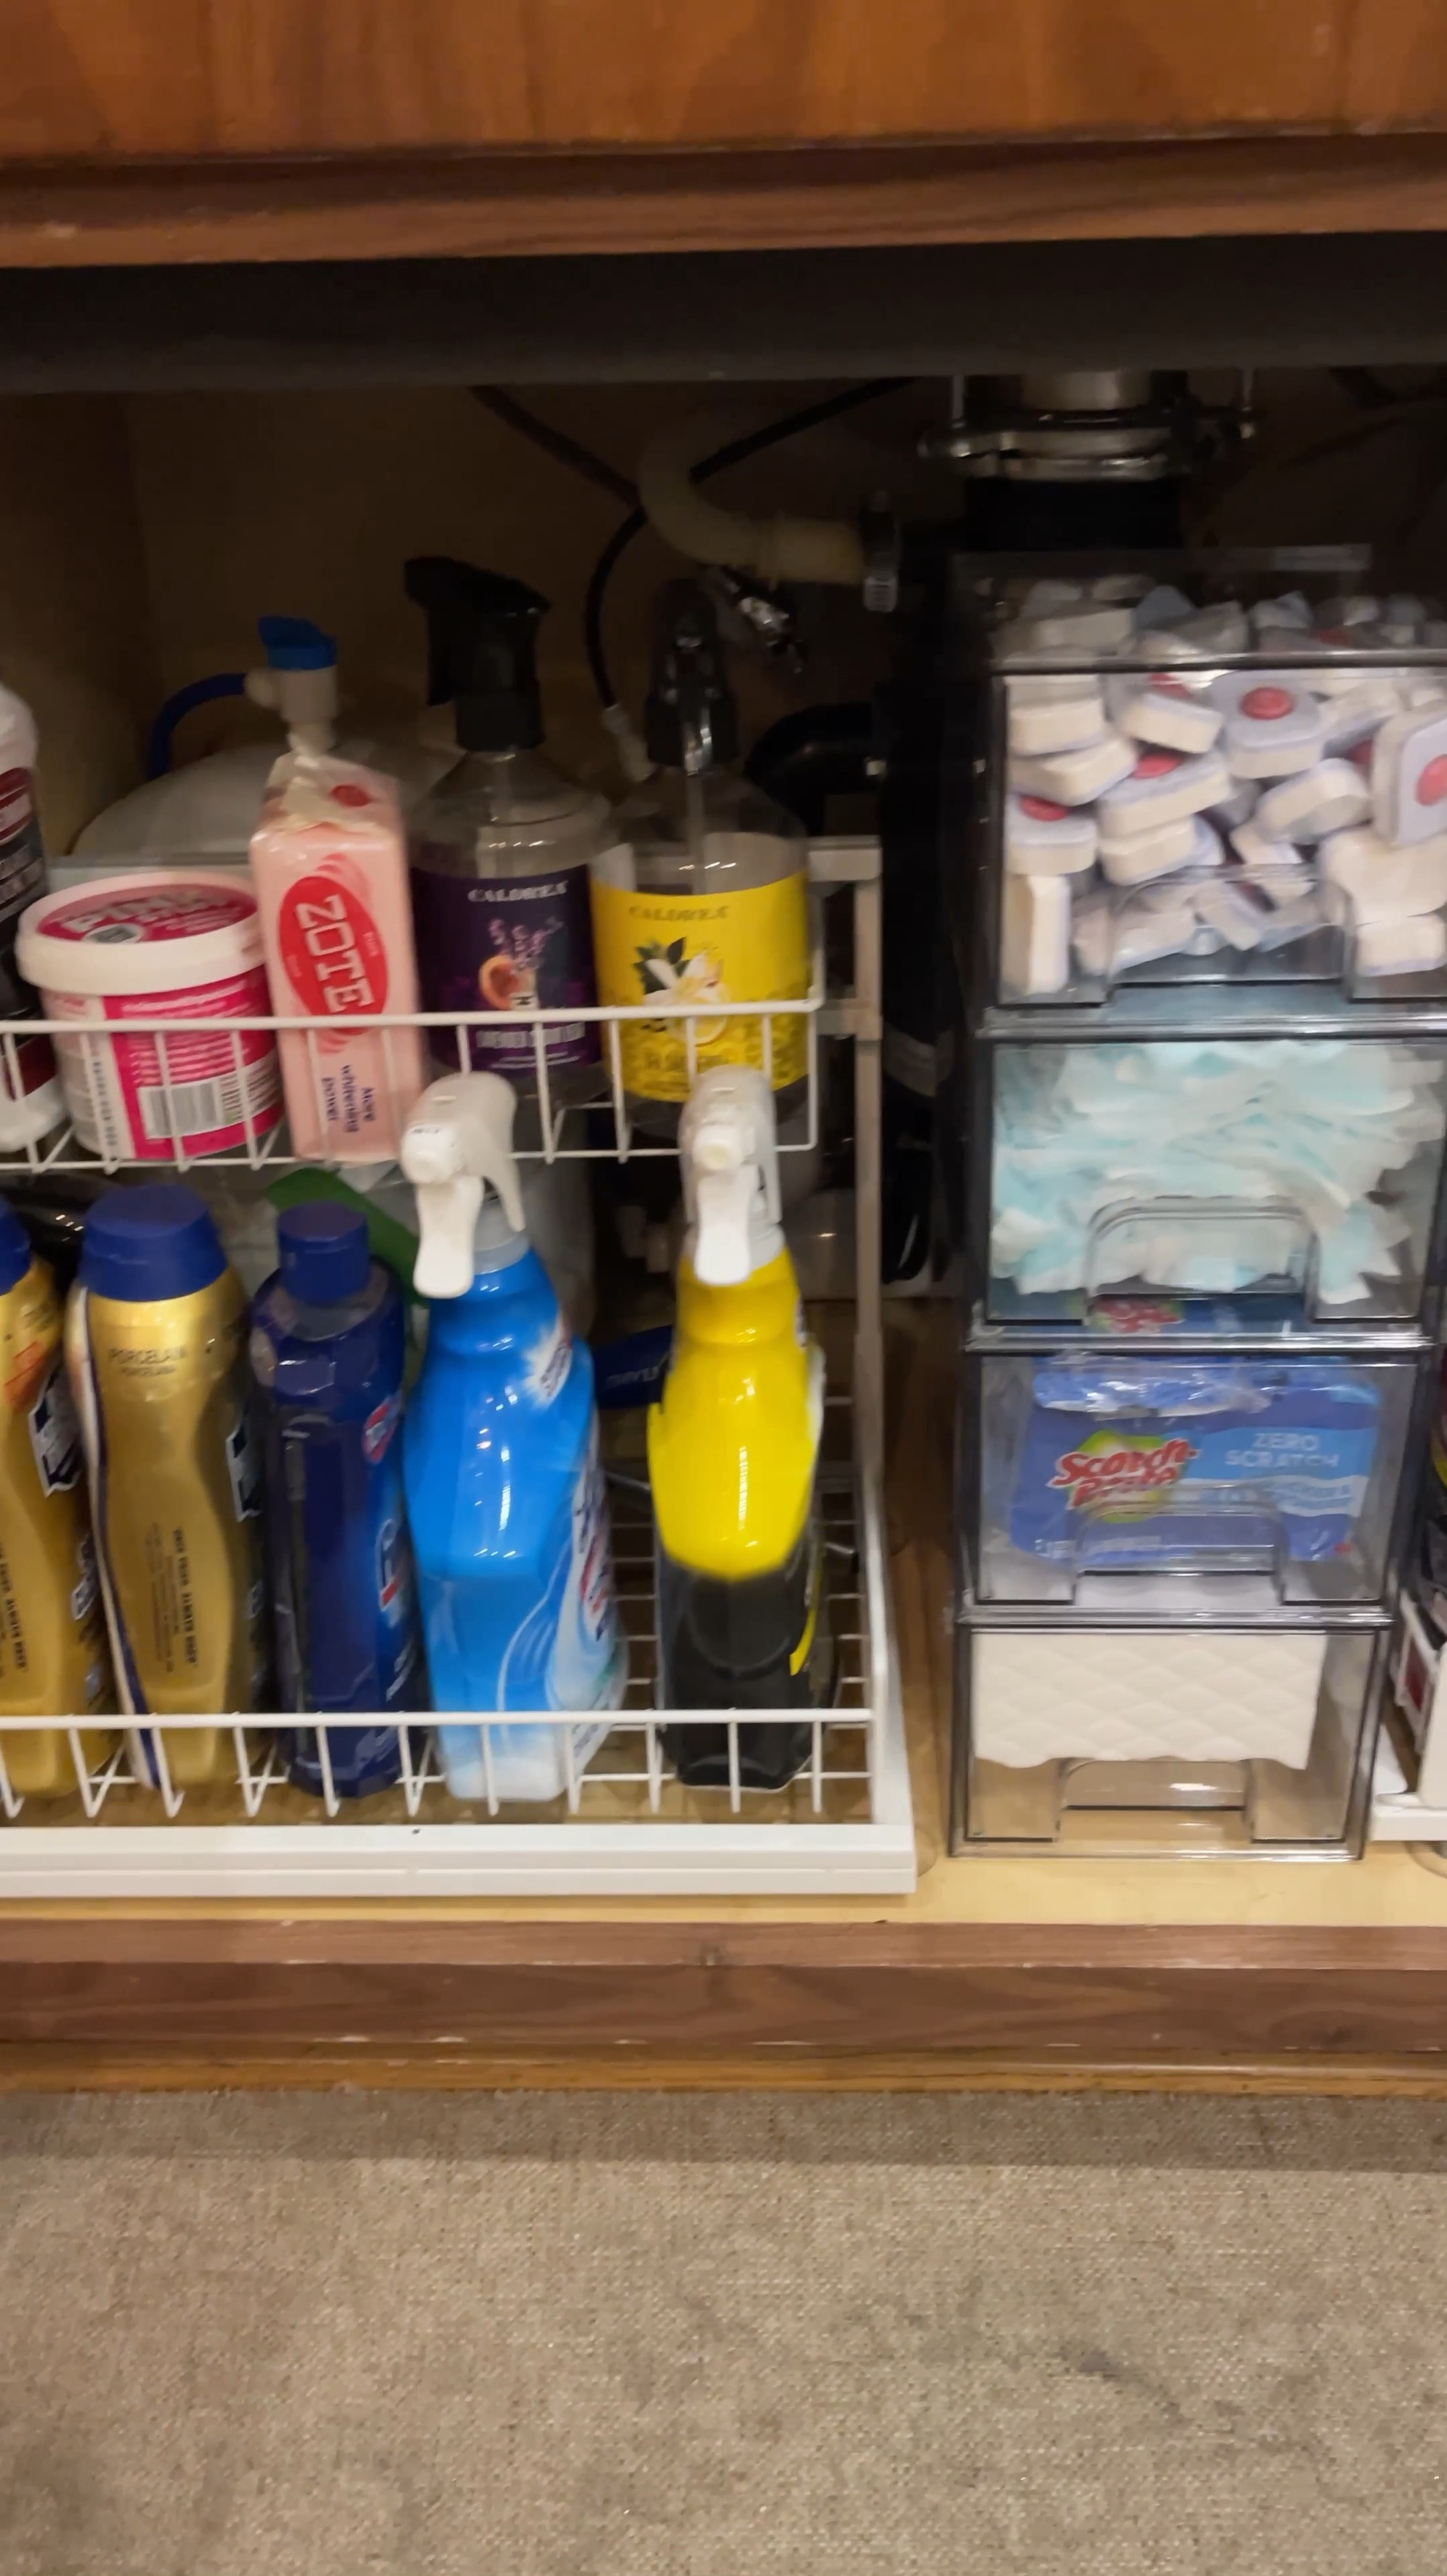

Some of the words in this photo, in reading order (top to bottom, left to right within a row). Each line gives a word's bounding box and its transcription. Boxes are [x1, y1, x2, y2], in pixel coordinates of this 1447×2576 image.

[295, 893, 375, 1013] ZOTE
[1252, 1432, 1319, 1452] ZERO
[1225, 1450, 1340, 1469] SCRATCH
